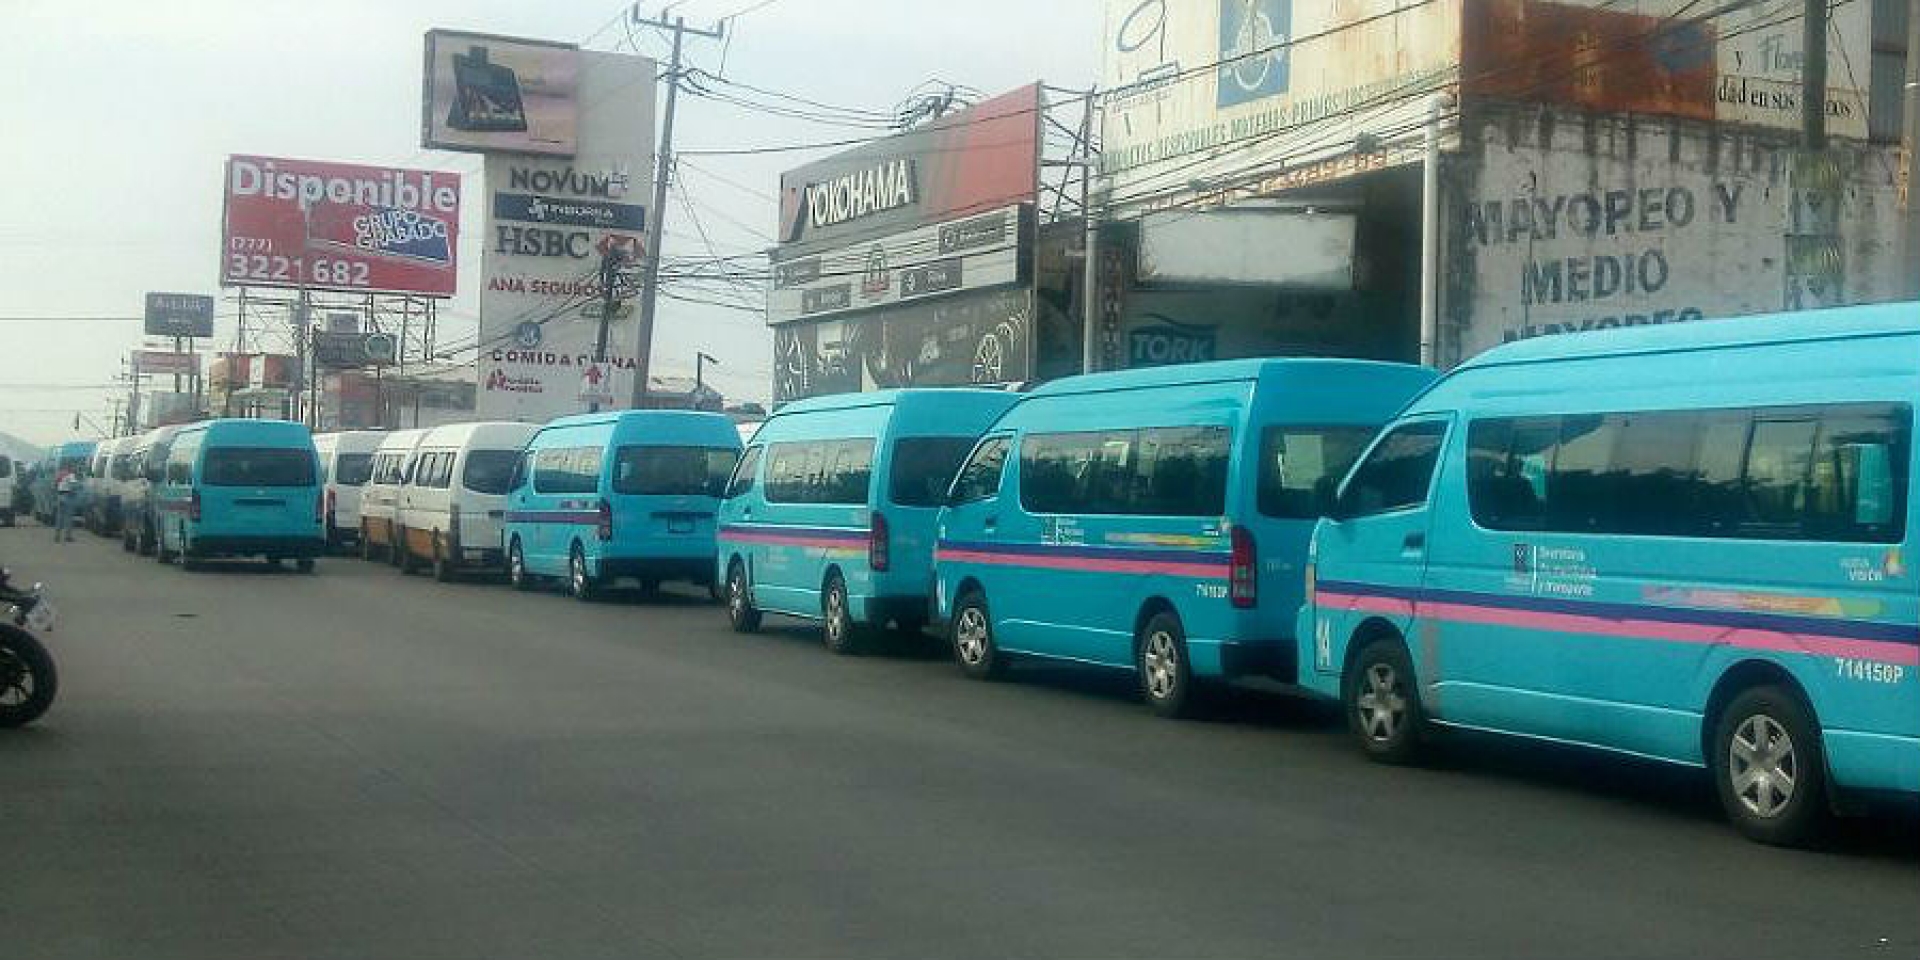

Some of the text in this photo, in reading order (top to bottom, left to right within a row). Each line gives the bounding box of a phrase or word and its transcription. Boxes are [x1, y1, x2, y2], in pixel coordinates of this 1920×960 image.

[231, 160, 459, 212] Disponible
[806, 159, 910, 228] YOKOHAMA
[1467, 183, 1743, 246] MAYOREO Y
[495, 225, 590, 259] HSBC
[488, 276, 525, 294] ANA
[1521, 248, 1668, 305] MEDIO
[493, 349, 571, 366] COMIDA
[1134, 333, 1209, 362] TORK
